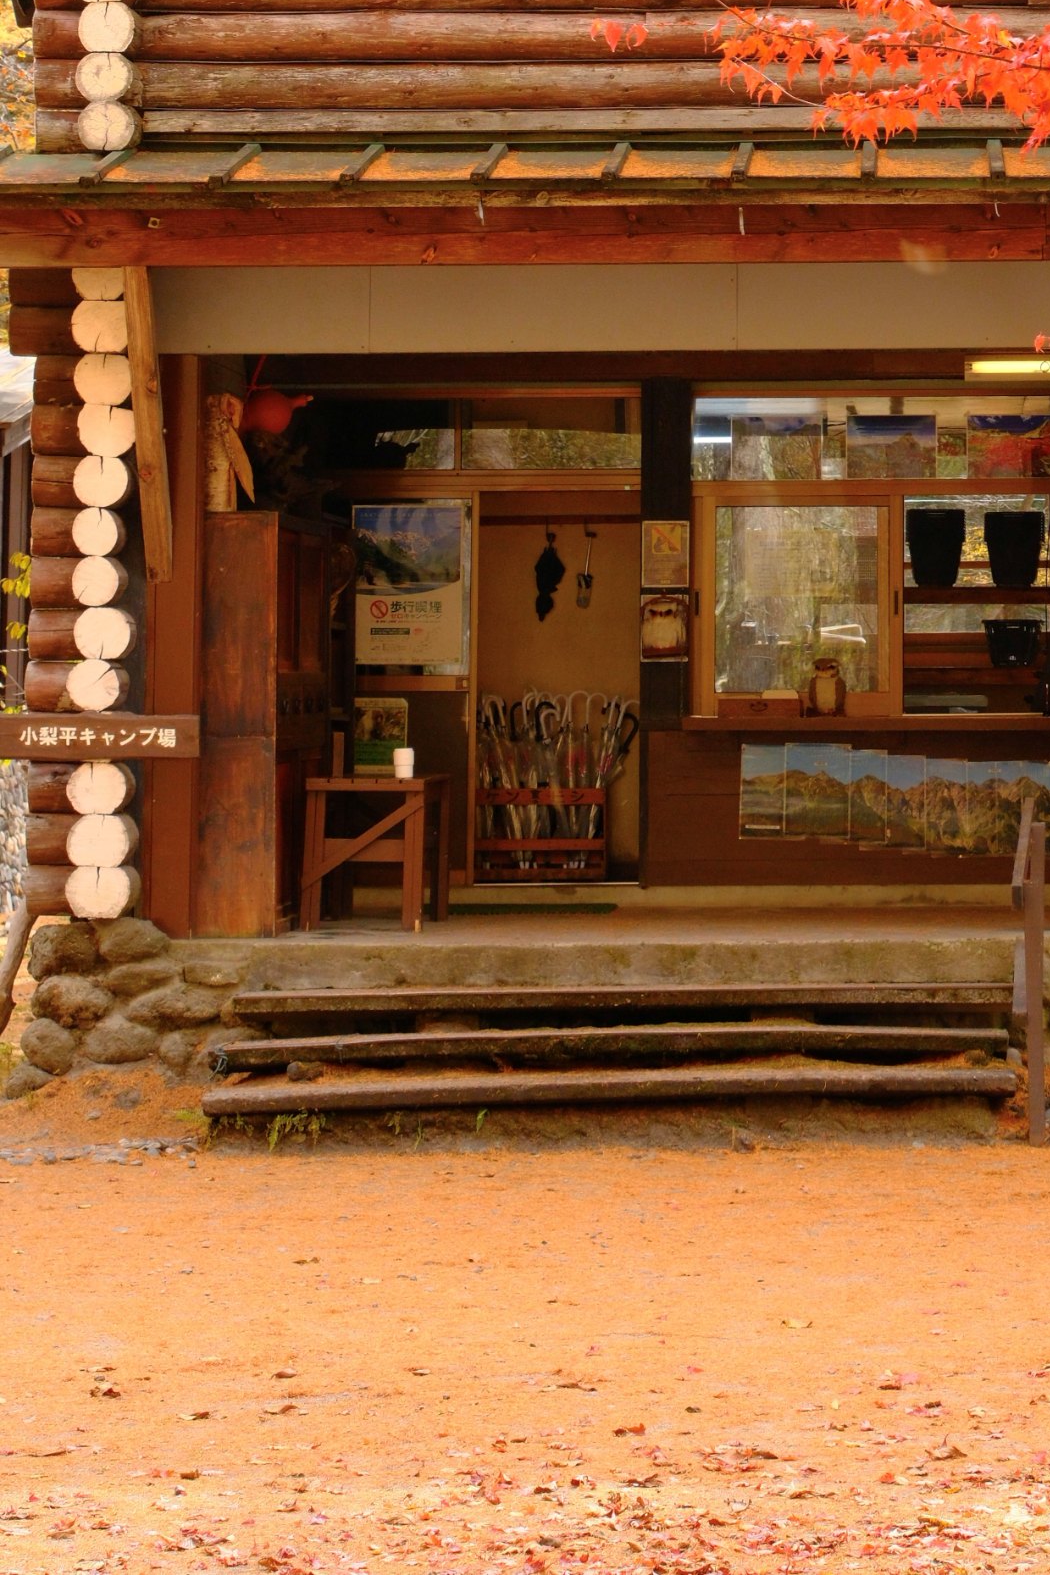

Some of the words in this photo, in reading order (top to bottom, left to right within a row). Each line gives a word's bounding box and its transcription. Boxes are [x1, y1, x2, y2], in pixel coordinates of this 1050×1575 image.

[19, 726, 177, 748] 小梨平キャンプ場
